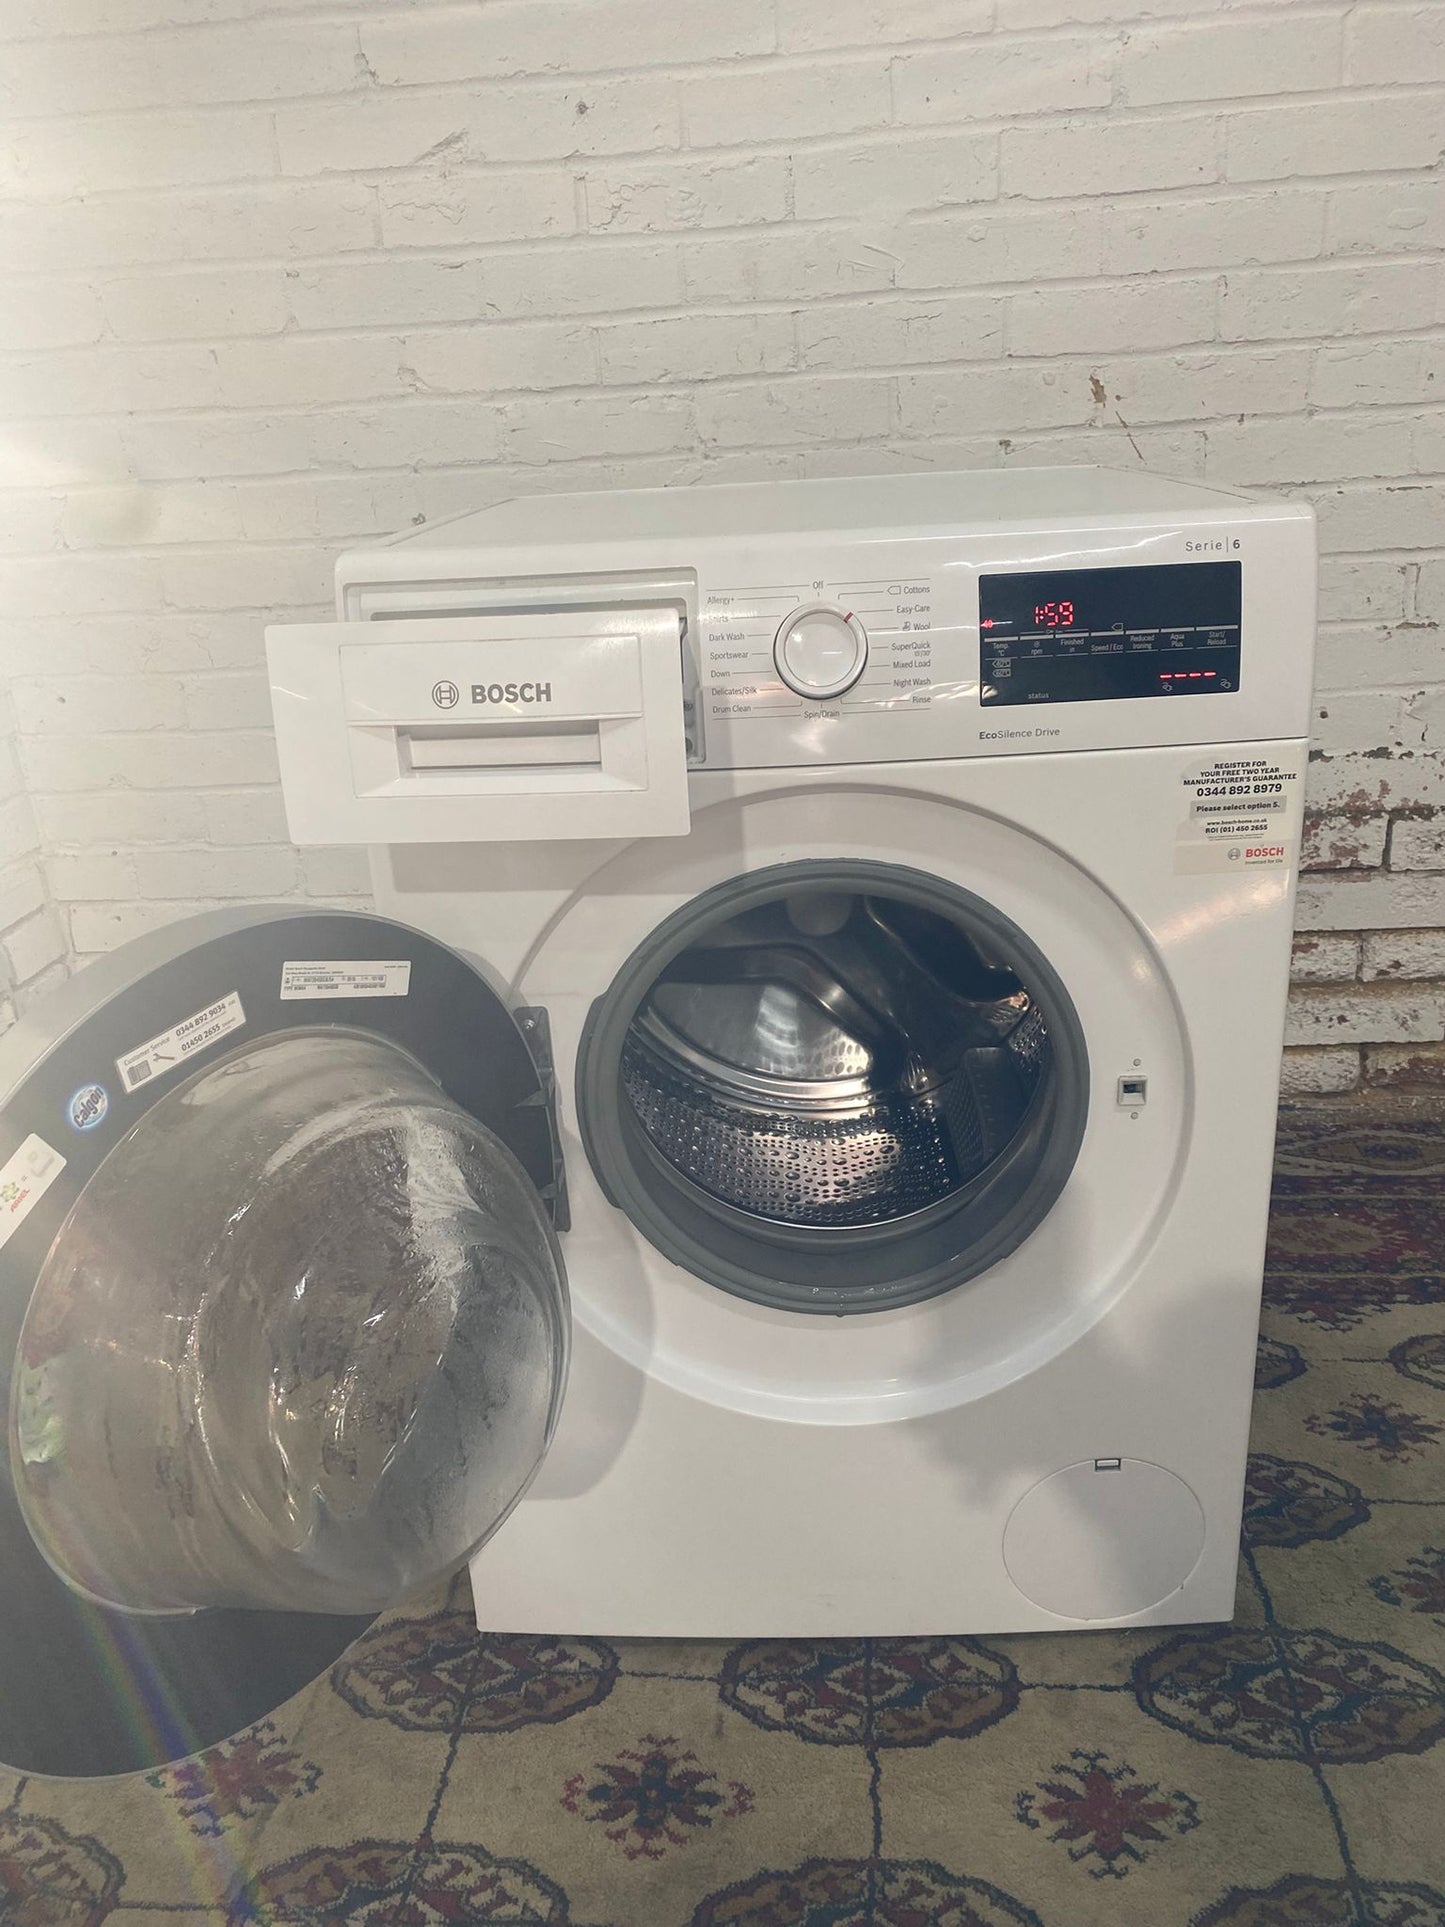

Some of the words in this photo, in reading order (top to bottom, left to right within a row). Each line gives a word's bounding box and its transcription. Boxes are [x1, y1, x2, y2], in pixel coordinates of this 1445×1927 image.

[1185, 540, 1222, 552] Serie
[1232, 539, 1241, 550] 6
[812, 580, 824, 589] Off
[903, 586, 931, 594] Cottons
[896, 605, 913, 614] Easy
[914, 604, 931, 613] Care
[1034, 601, 1074, 627] 1:59
[913, 622, 931, 631] Wool
[708, 633, 726, 642] Dark
[726, 632, 745, 641] Wash
[1060, 638, 1085, 646] Finished
[1130, 634, 1155, 642] Reduced
[891, 641, 931, 652] SuperQuick
[709, 651, 749, 661] Sportswear
[892, 661, 914, 669] Mixed
[914, 659, 931, 668] Load
[710, 670, 731, 678] Down
[893, 679, 912, 689] Night
[912, 678, 932, 686] Wash
[471, 682, 552, 704] BOSCH
[711, 686, 758, 696] Delicates/Silk
[1028, 692, 1050, 700] status
[912, 696, 931, 704] Rinse
[712, 705, 732, 714] Drum
[732, 704, 752, 713] Clean
[803, 709, 840, 719] Spin/Drain
[979, 728, 1033, 740] EcoSilence
[1034, 727, 1061, 738] Drive
[1214, 761, 1251, 770] REGISTER
[1251, 760, 1267, 768] FOR
[1200, 770, 1221, 778] YOUR
[1221, 769, 1241, 777] FREE
[1242, 768, 1259, 776] TWO
[1183, 776, 1251, 785] MANUFACTURER'S
[1252, 773, 1298, 782] GUARANTEE
[1196, 786, 1227, 797] 0344
[1229, 785, 1251, 795] 892
[1253, 783, 1282, 794] 8979
[1196, 804, 1222, 812] Please
[1222, 803, 1246, 811] select
[1246, 801, 1272, 811] option
[1219, 825, 1235, 833] (01)
[1245, 847, 1285, 858] BOSCH
[175, 1021, 195, 1037] 0344
[194, 1012, 209, 1027] 892
[208, 1003, 227, 1018] 9034
[180, 1033, 204, 1051] 01450
[203, 1023, 221, 1039] 2655
[123, 1048, 151, 1067] Customer
[150, 1036, 171, 1052] Service
[73, 1086, 104, 1128] Calgon
